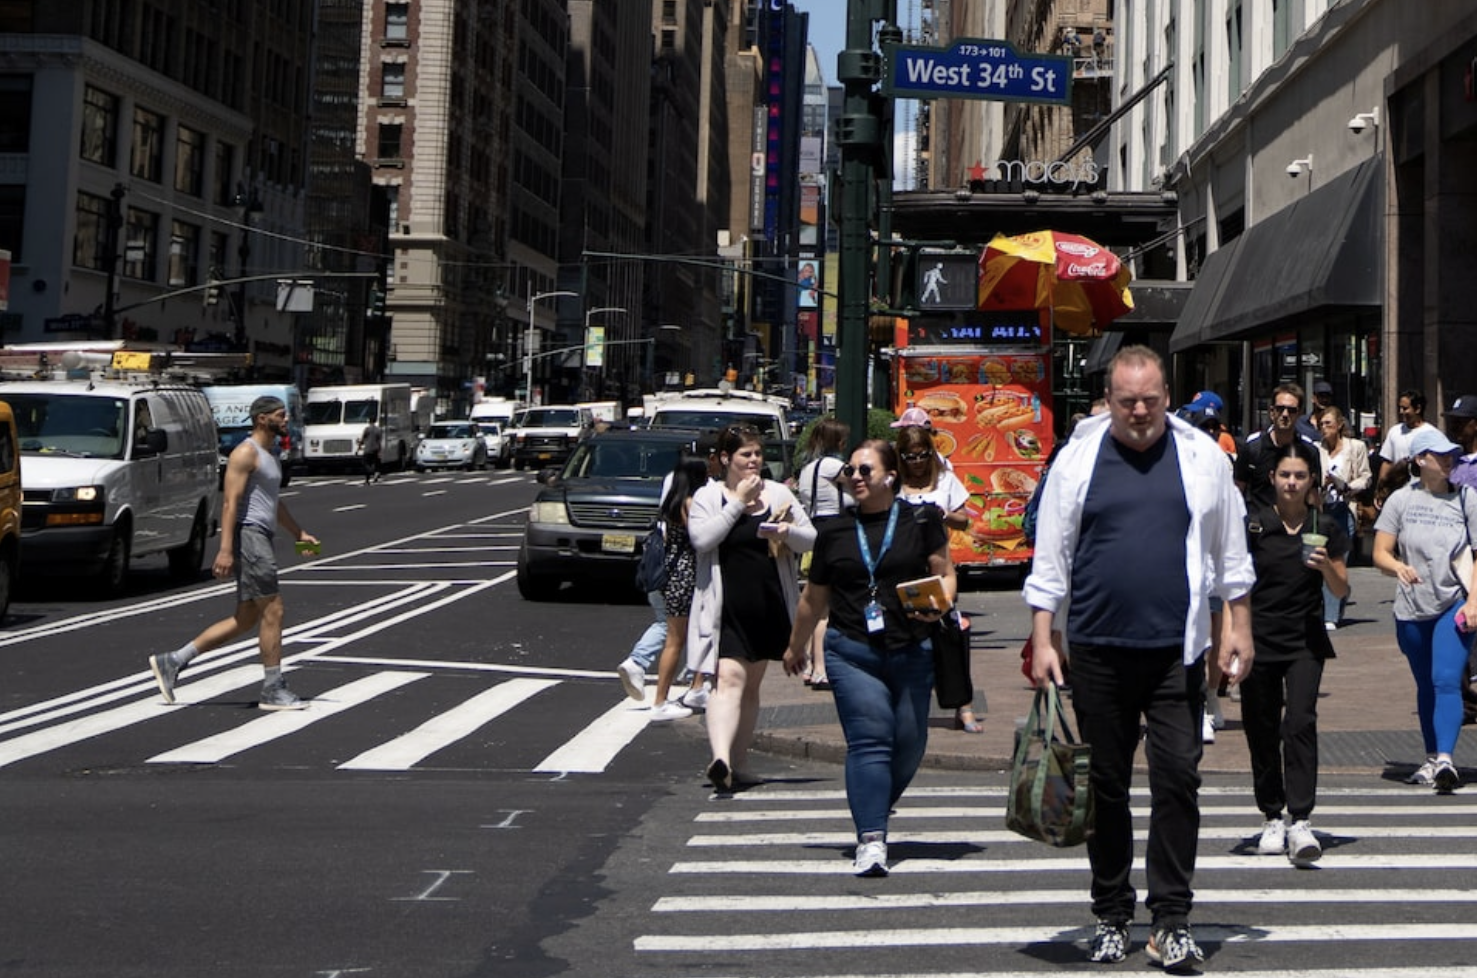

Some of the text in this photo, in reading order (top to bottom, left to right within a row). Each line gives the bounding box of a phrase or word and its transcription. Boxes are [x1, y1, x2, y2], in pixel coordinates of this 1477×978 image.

[906, 58, 1056, 92] West 34th St
[996, 157, 1099, 190] macy's
